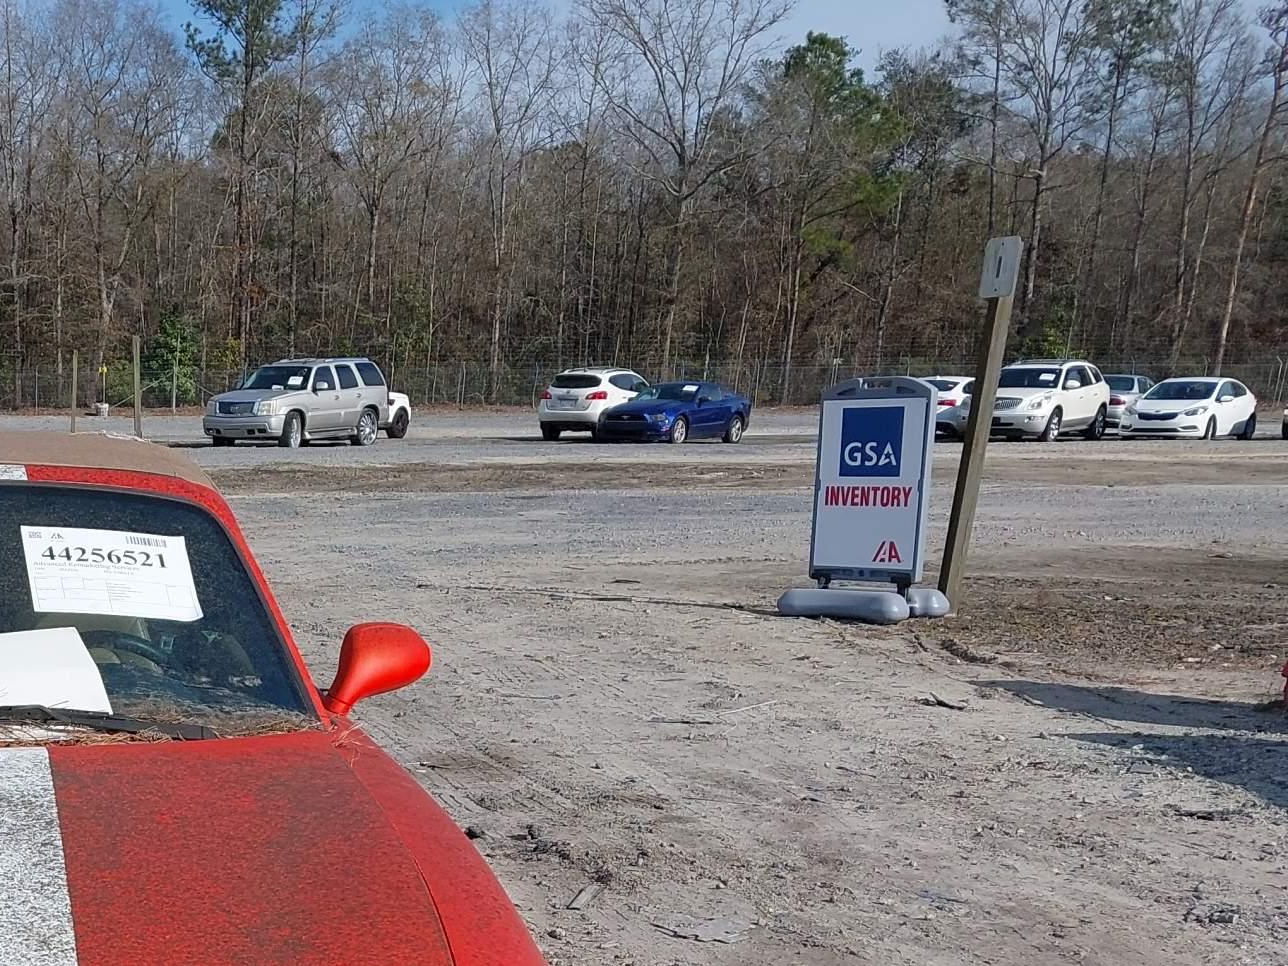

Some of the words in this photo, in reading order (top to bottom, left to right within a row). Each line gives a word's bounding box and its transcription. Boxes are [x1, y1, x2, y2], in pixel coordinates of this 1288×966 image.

[844, 442, 897, 466] GSA
[824, 486, 913, 507] INVENTORY
[41, 546, 168, 568] 44256521
